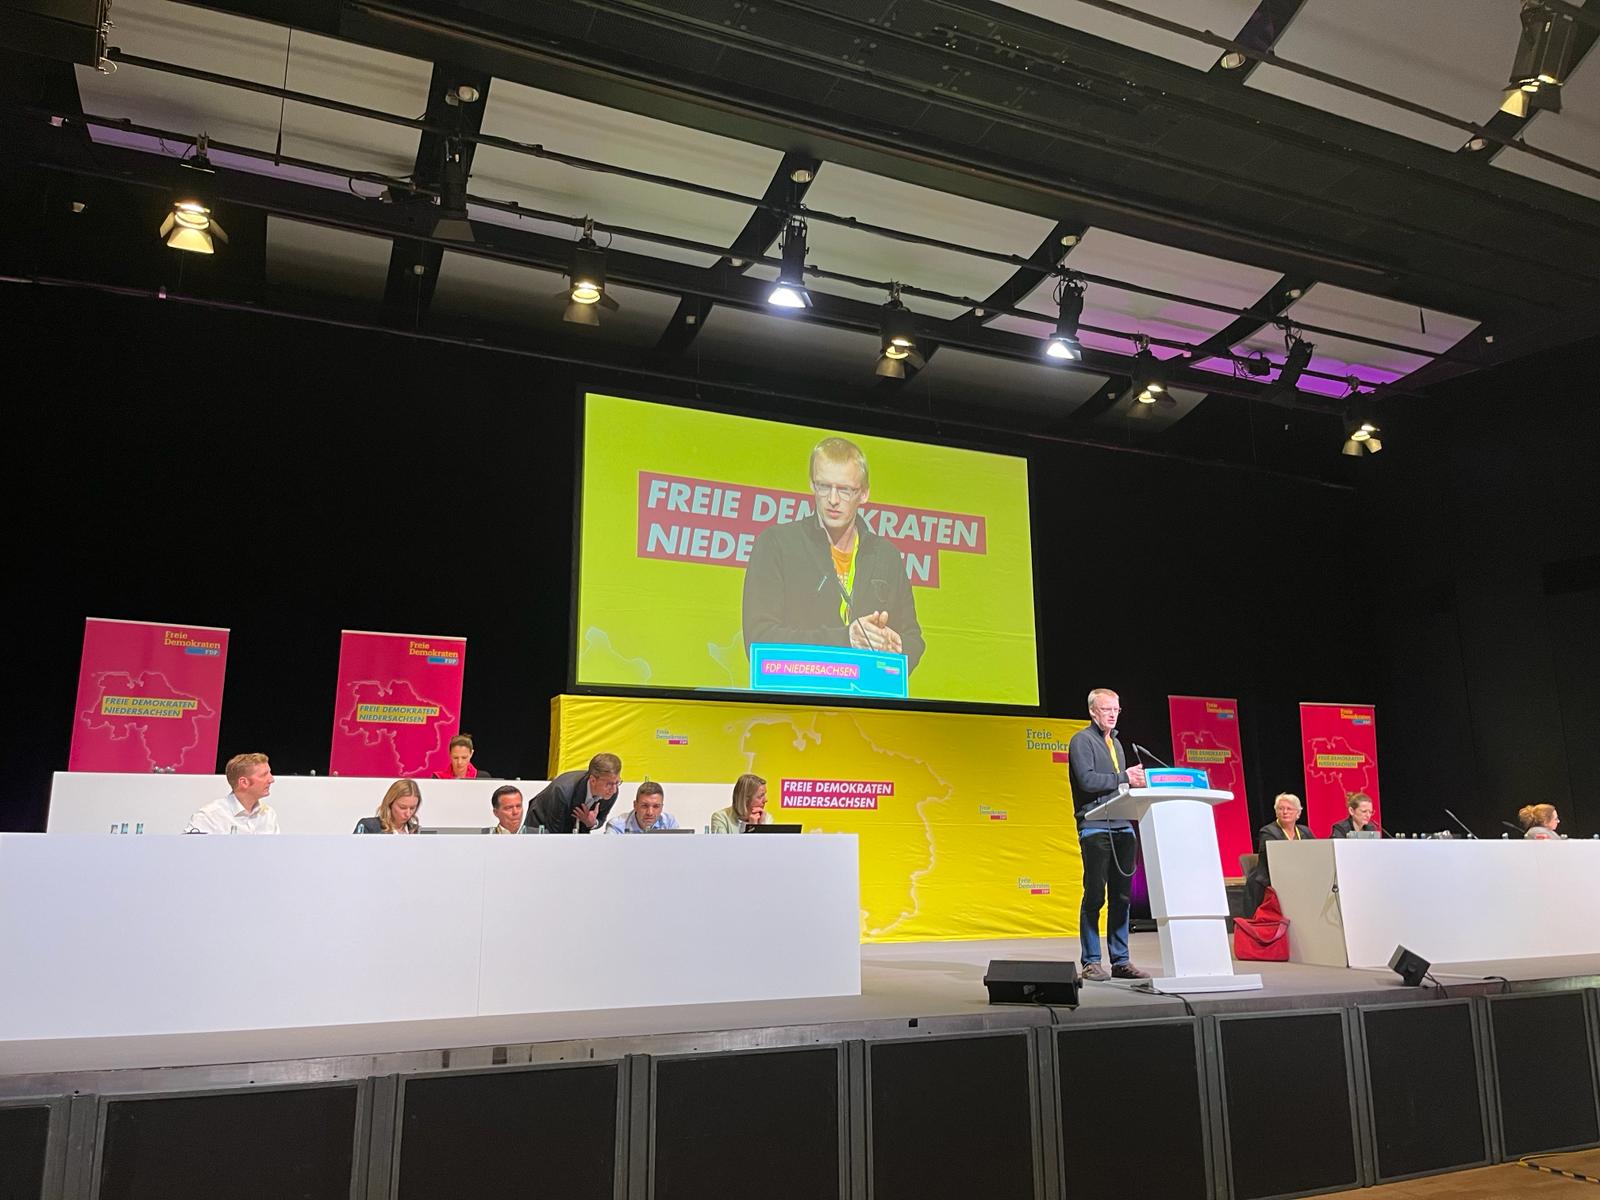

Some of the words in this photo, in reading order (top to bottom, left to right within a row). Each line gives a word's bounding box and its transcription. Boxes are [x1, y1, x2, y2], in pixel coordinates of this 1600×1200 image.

[647, 479, 742, 519] FREIE
[165, 631, 188, 639] Freie
[164, 639, 221, 649] Demokraten
[410, 641, 430, 649] Freie
[409, 649, 459, 658] Demokraten
[765, 663, 781, 673] FDP
[783, 663, 858, 677] NIEDERSACHSEN
[105, 697, 129, 706] FREIE
[131, 699, 196, 708] DEMOKRATEN
[104, 706, 181, 717] NIEDERSACHSEN
[383, 706, 438, 715] DEMOKRATEN
[359, 714, 425, 723] NIEDERSACHSEN
[1026, 728, 1053, 739] Freie
[1026, 740, 1069, 751] Demokr
[783, 781, 812, 792] FREIE
[815, 782, 892, 794] DEMOKRATEN
[783, 795, 875, 808] NIEDERSACHSEN
